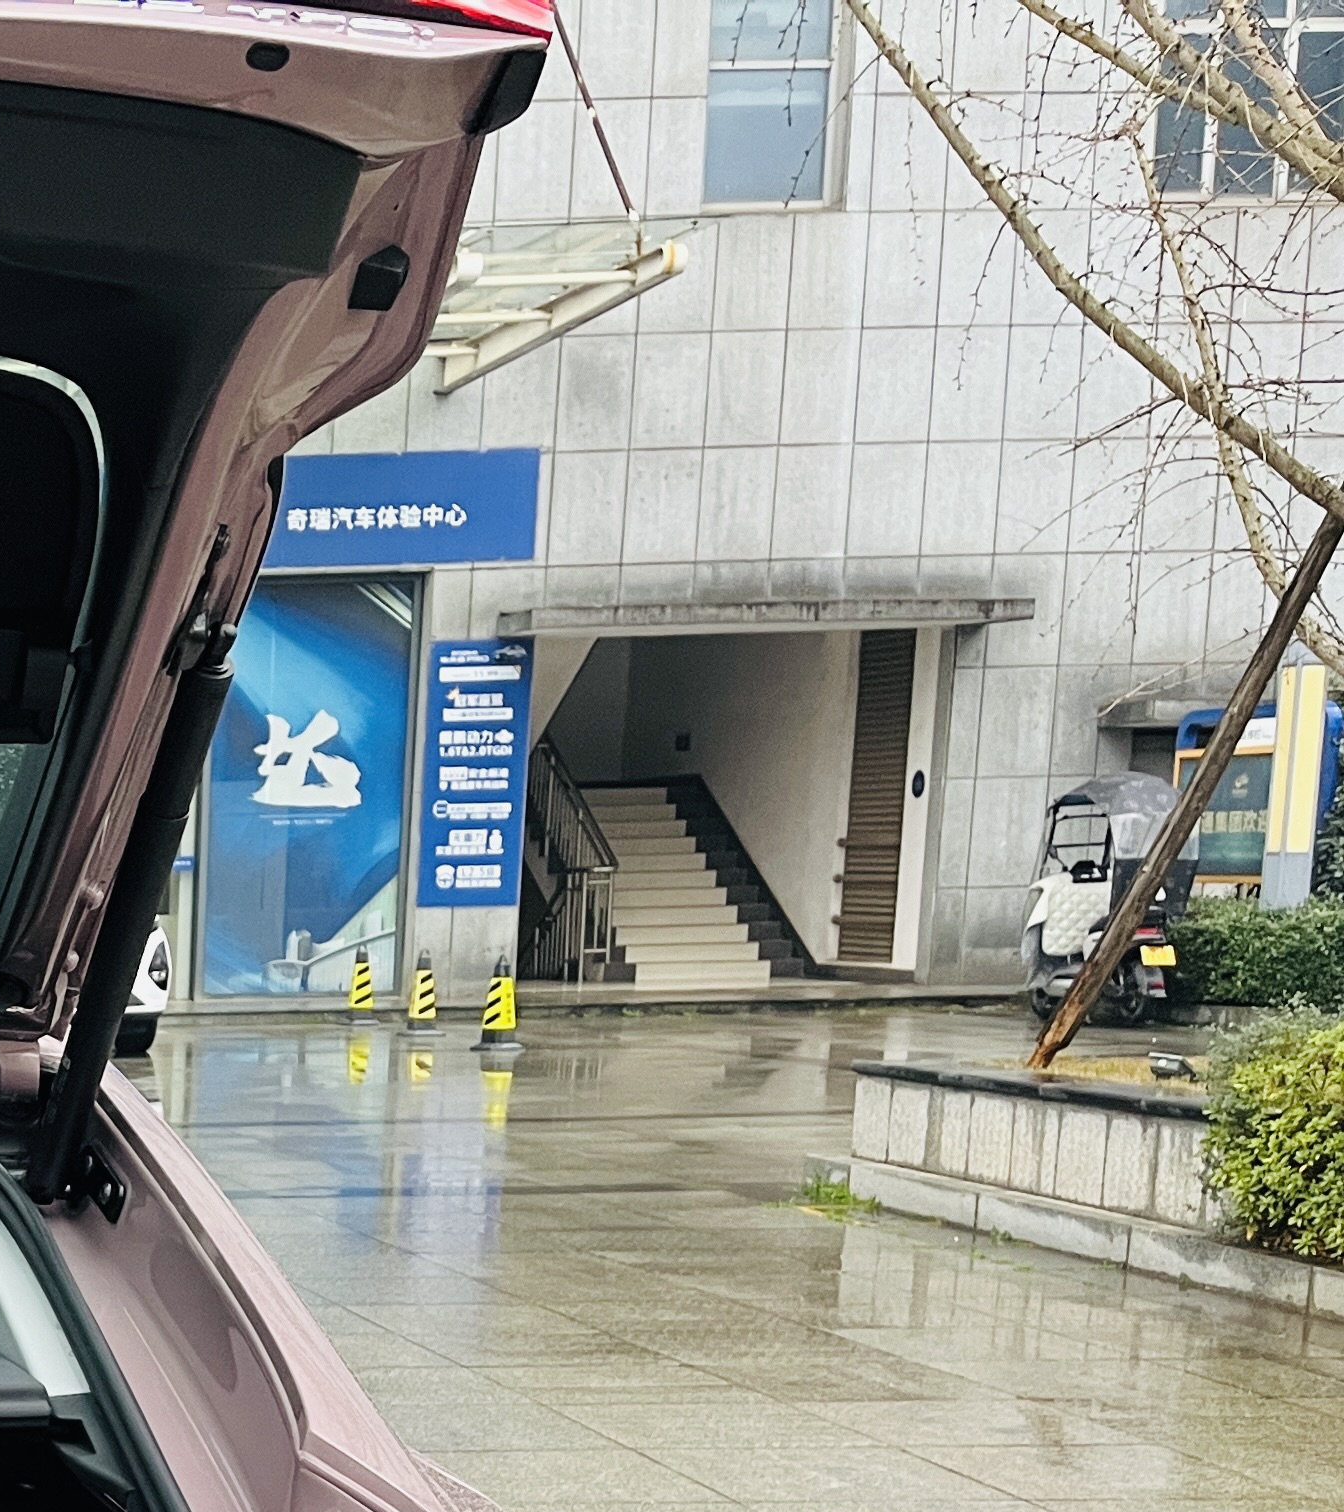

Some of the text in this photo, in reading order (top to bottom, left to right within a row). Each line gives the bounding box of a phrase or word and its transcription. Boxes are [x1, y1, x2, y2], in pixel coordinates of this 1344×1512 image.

[286, 503, 468, 531] 奇瑞汽车体验中心
